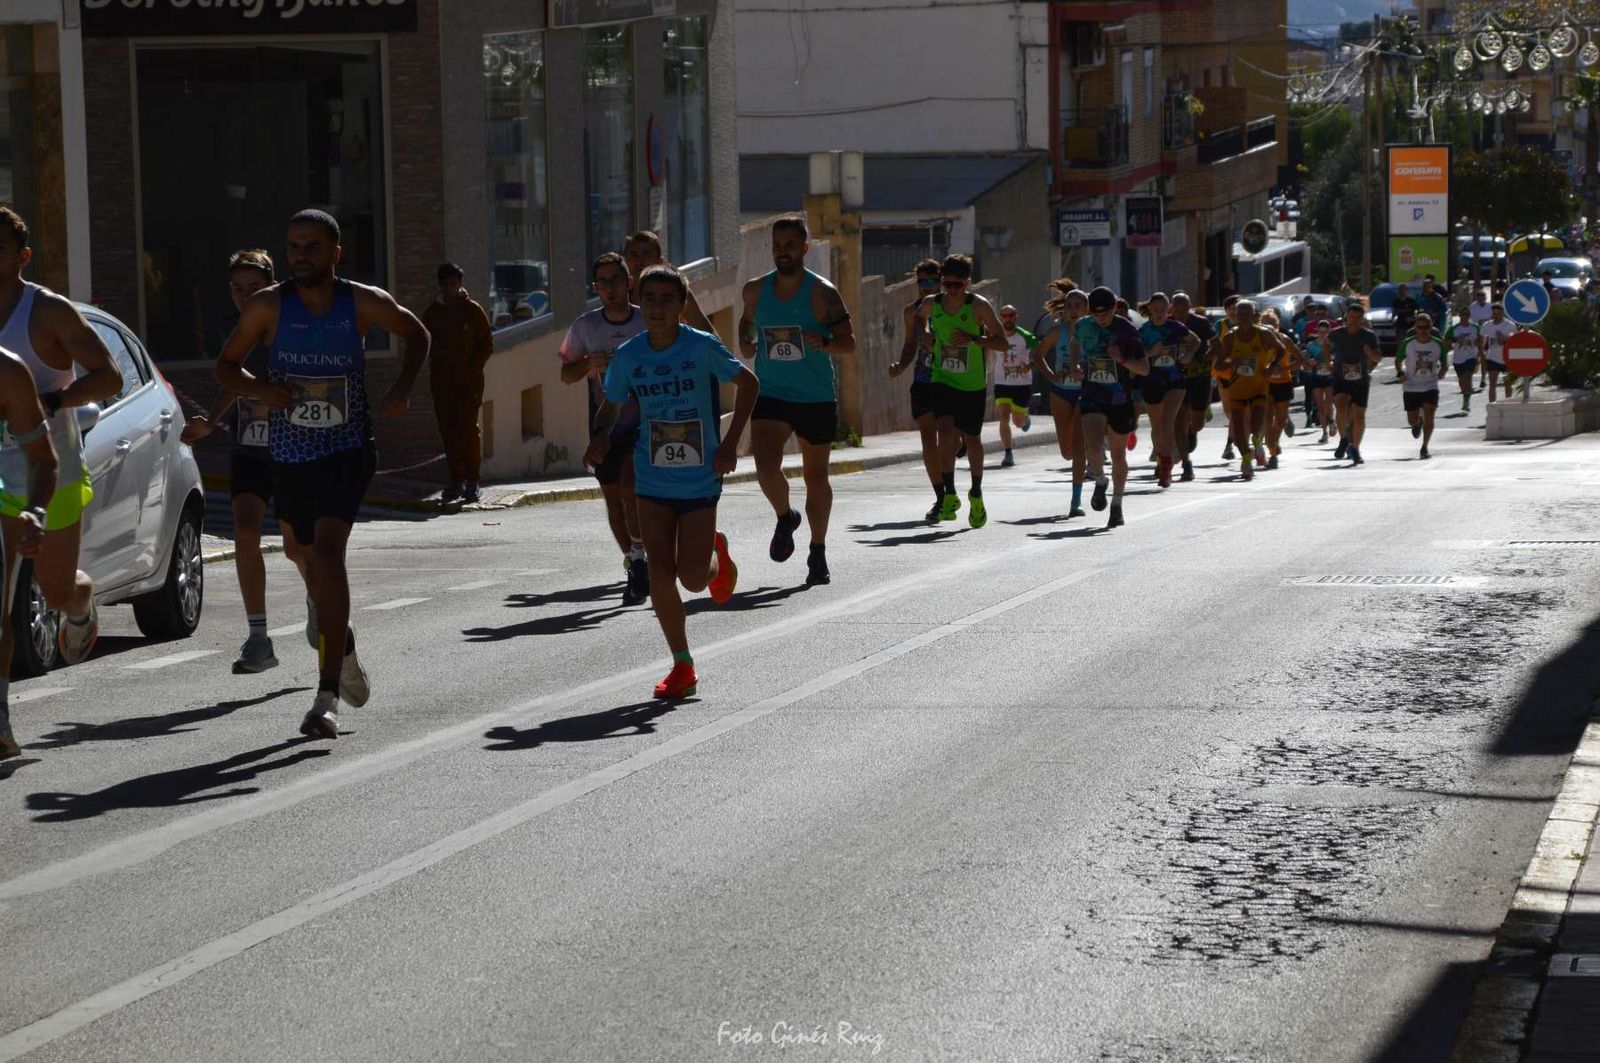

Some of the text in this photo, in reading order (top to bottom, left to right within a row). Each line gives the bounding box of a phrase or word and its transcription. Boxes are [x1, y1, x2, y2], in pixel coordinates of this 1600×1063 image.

[1394, 166, 1442, 176] consum
[777, 344, 792, 356] 68
[636, 375, 695, 397] nerja
[299, 404, 332, 420] 281
[665, 445, 687, 461] 94
